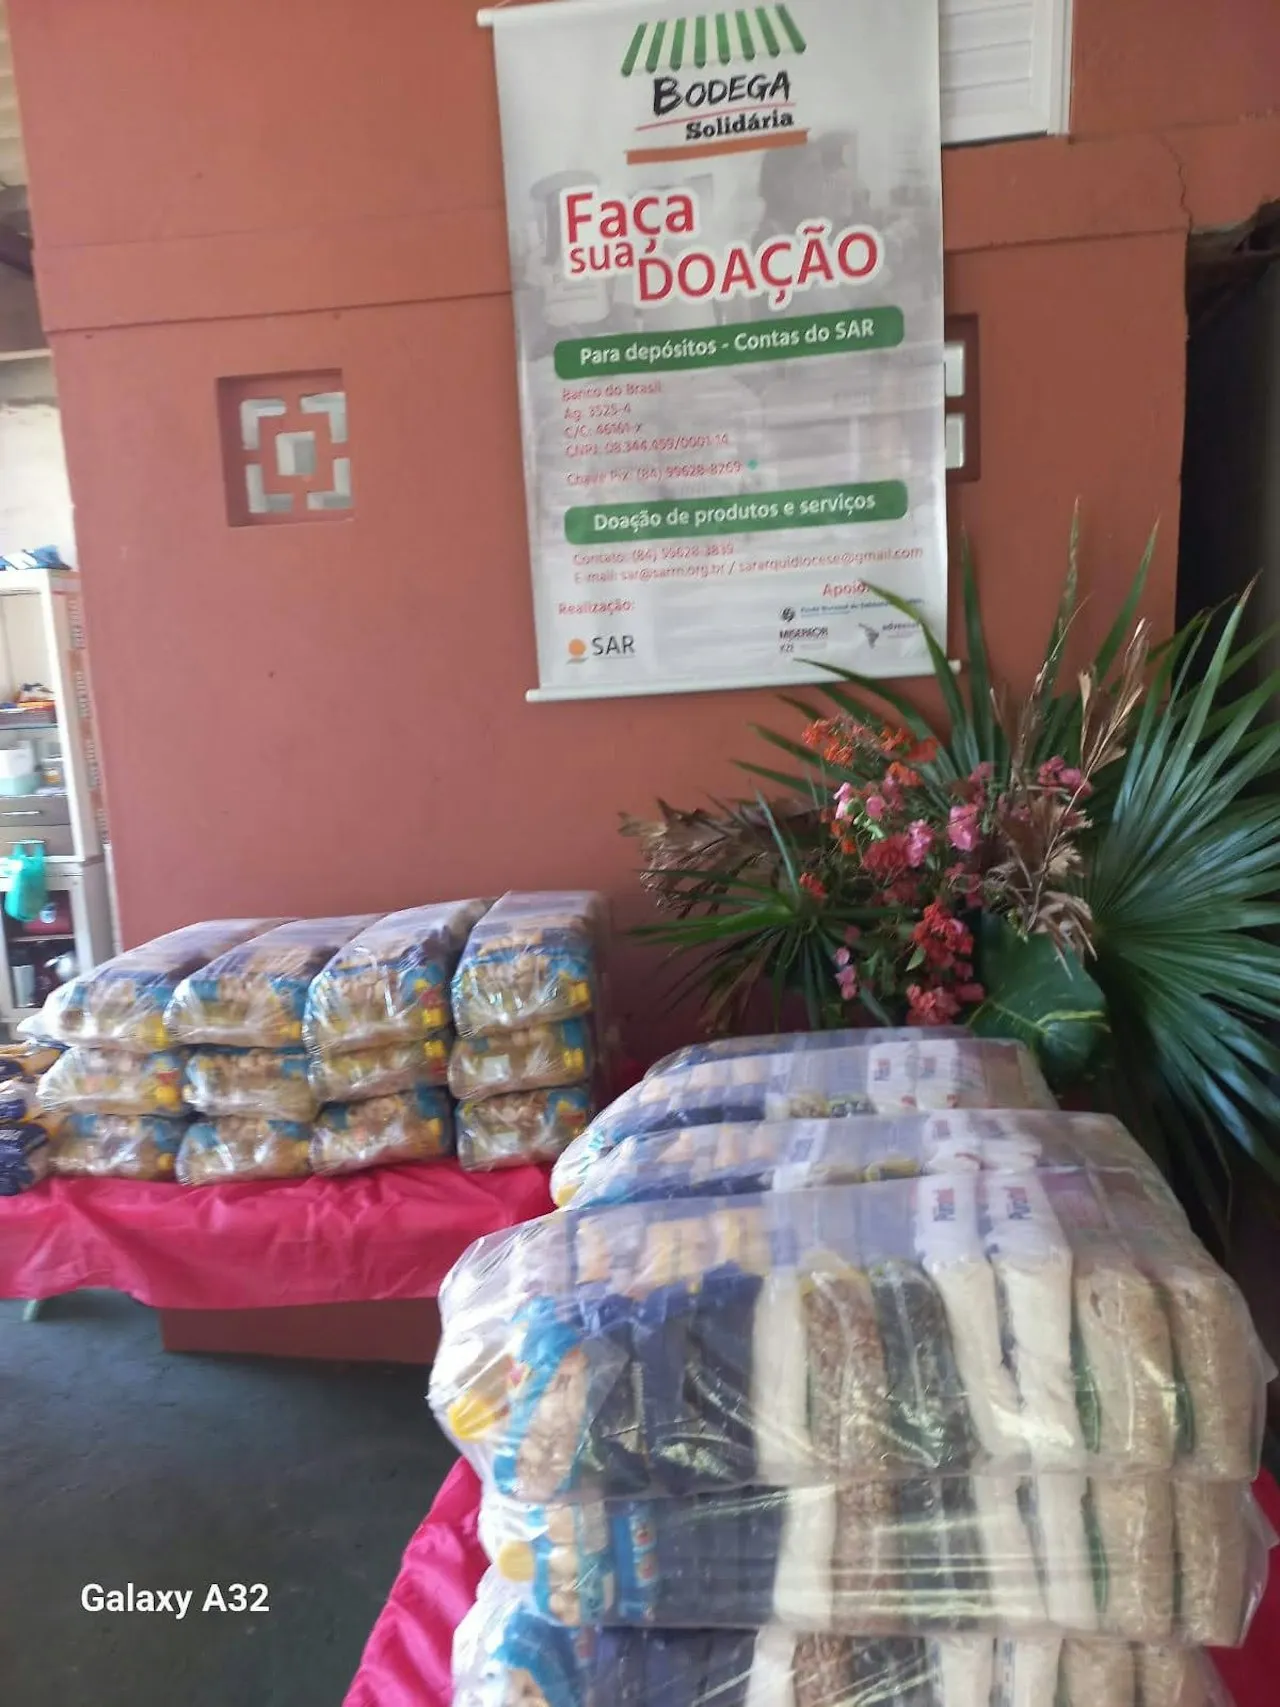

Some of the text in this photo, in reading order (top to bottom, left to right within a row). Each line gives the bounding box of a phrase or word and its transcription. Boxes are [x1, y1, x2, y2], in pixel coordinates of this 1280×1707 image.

[653, 70, 790, 116] BODEGA
[686, 111, 794, 140] Solidária
[565, 191, 695, 254] Faça
[570, 225, 878, 304] sua DOAÇÃO
[580, 346, 620, 366] Para
[624, 337, 717, 365] depósitos
[734, 330, 800, 352] Contas
[805, 323, 830, 343] do
[835, 318, 874, 341] SAR
[605, 384, 622, 397] do
[626, 380, 662, 395] Brasil
[594, 492, 875, 533] Doação de produtos e serviços
[592, 635, 635, 656] SAR
